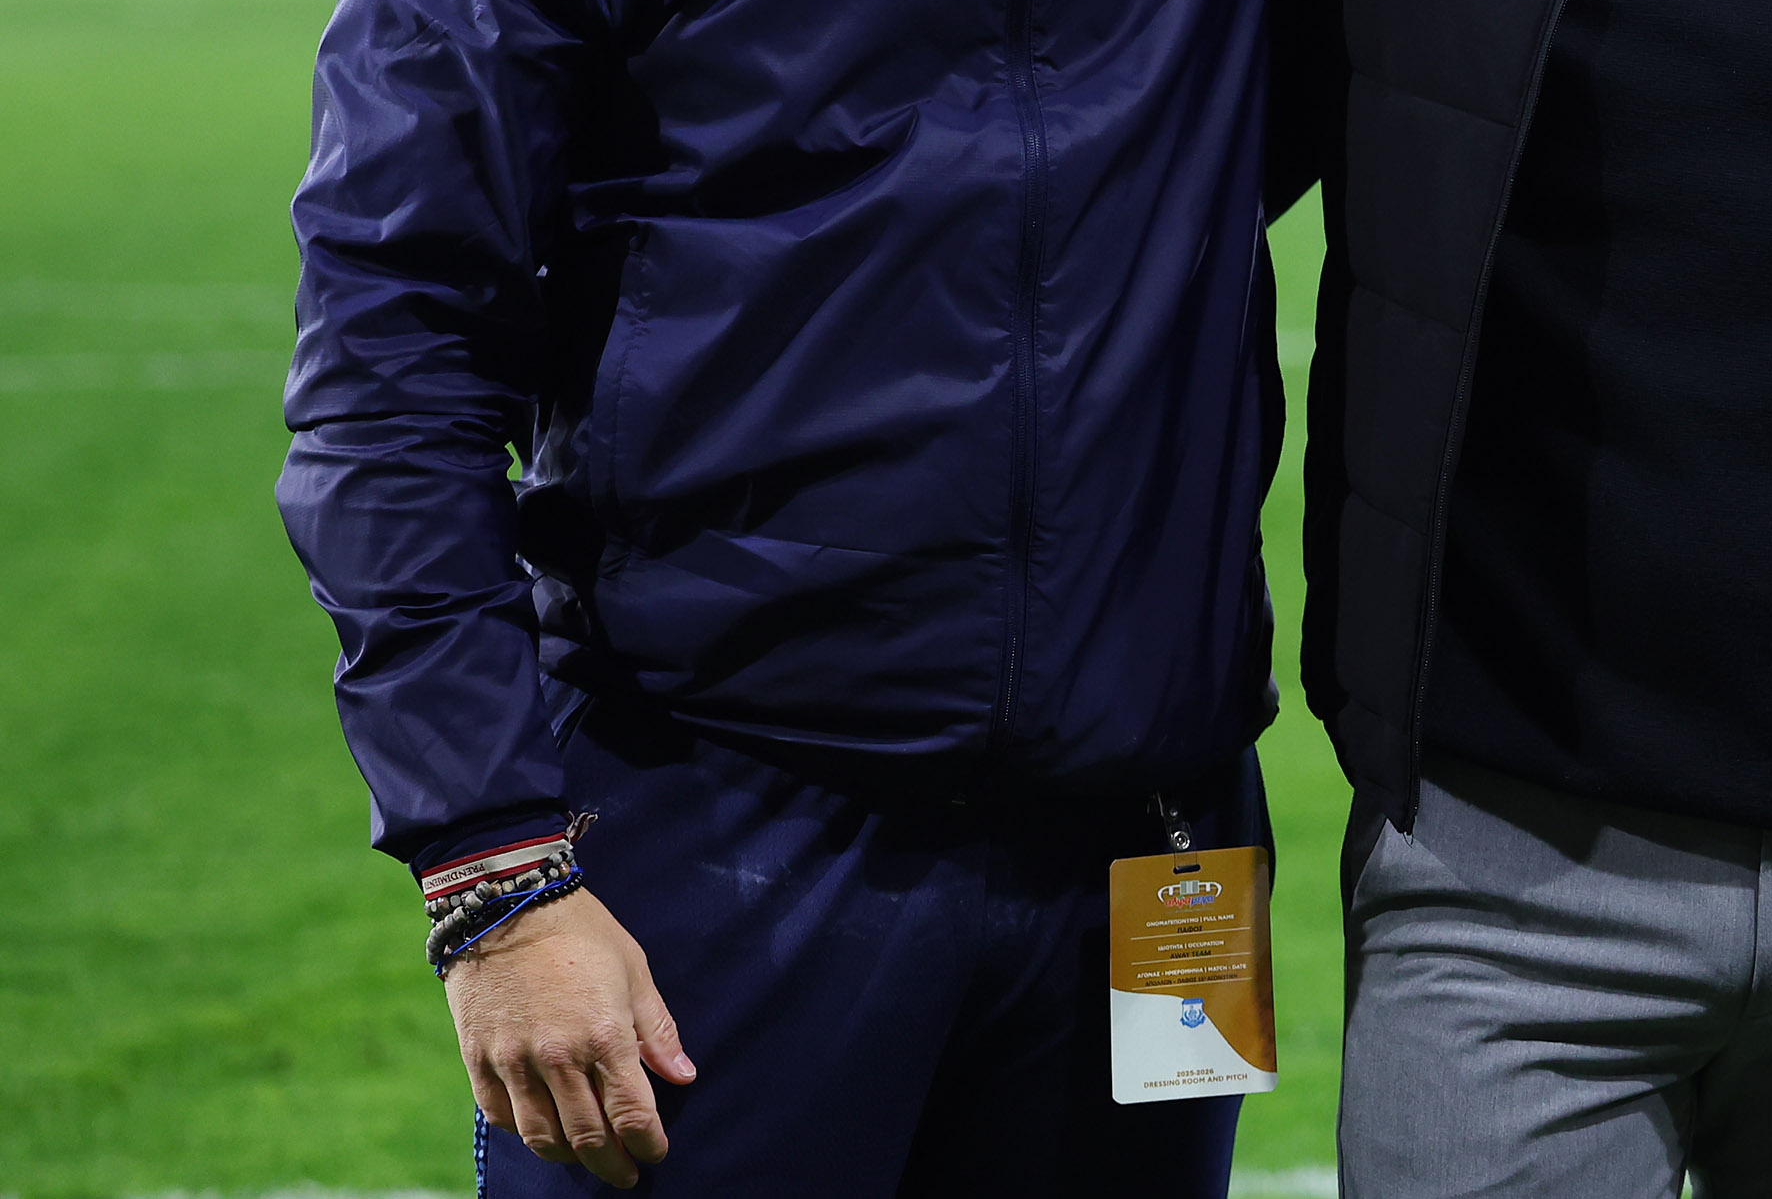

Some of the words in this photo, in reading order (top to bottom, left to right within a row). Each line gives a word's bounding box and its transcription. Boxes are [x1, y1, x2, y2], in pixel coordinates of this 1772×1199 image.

[1170, 951, 1190, 959] AWAY
[1144, 1079, 1180, 1089] DRESSING
[1182, 1077, 1205, 1085] ROOM
[1207, 1075, 1224, 1083] AND
[1226, 1073, 1248, 1081] PITCH
